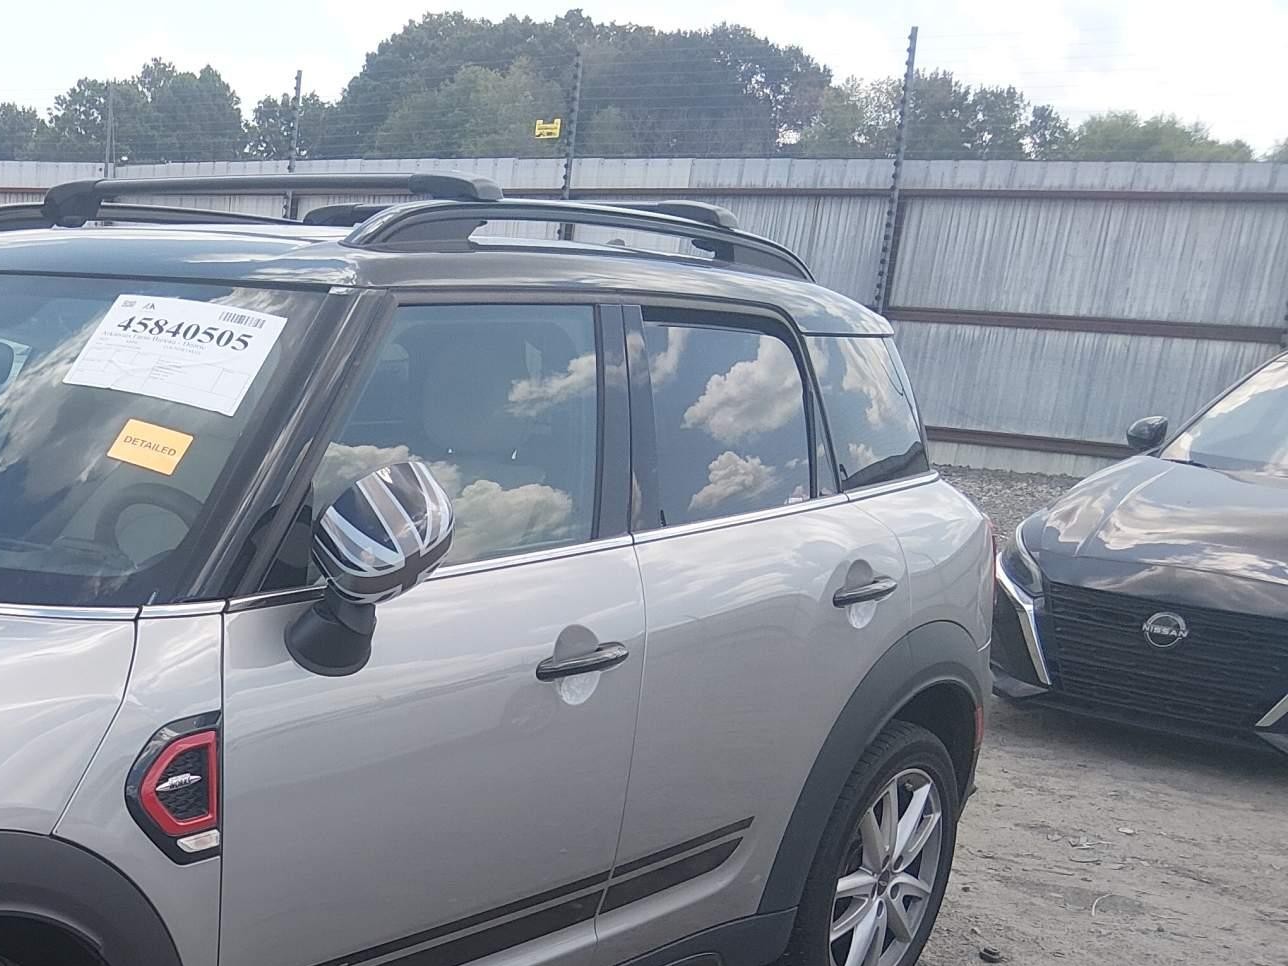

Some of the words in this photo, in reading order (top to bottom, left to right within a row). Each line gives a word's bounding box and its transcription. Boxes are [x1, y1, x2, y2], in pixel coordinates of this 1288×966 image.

[117, 316, 253, 352] 45840505
[122, 434, 177, 457] DETAILED
[1142, 622, 1189, 638] NISSAN
